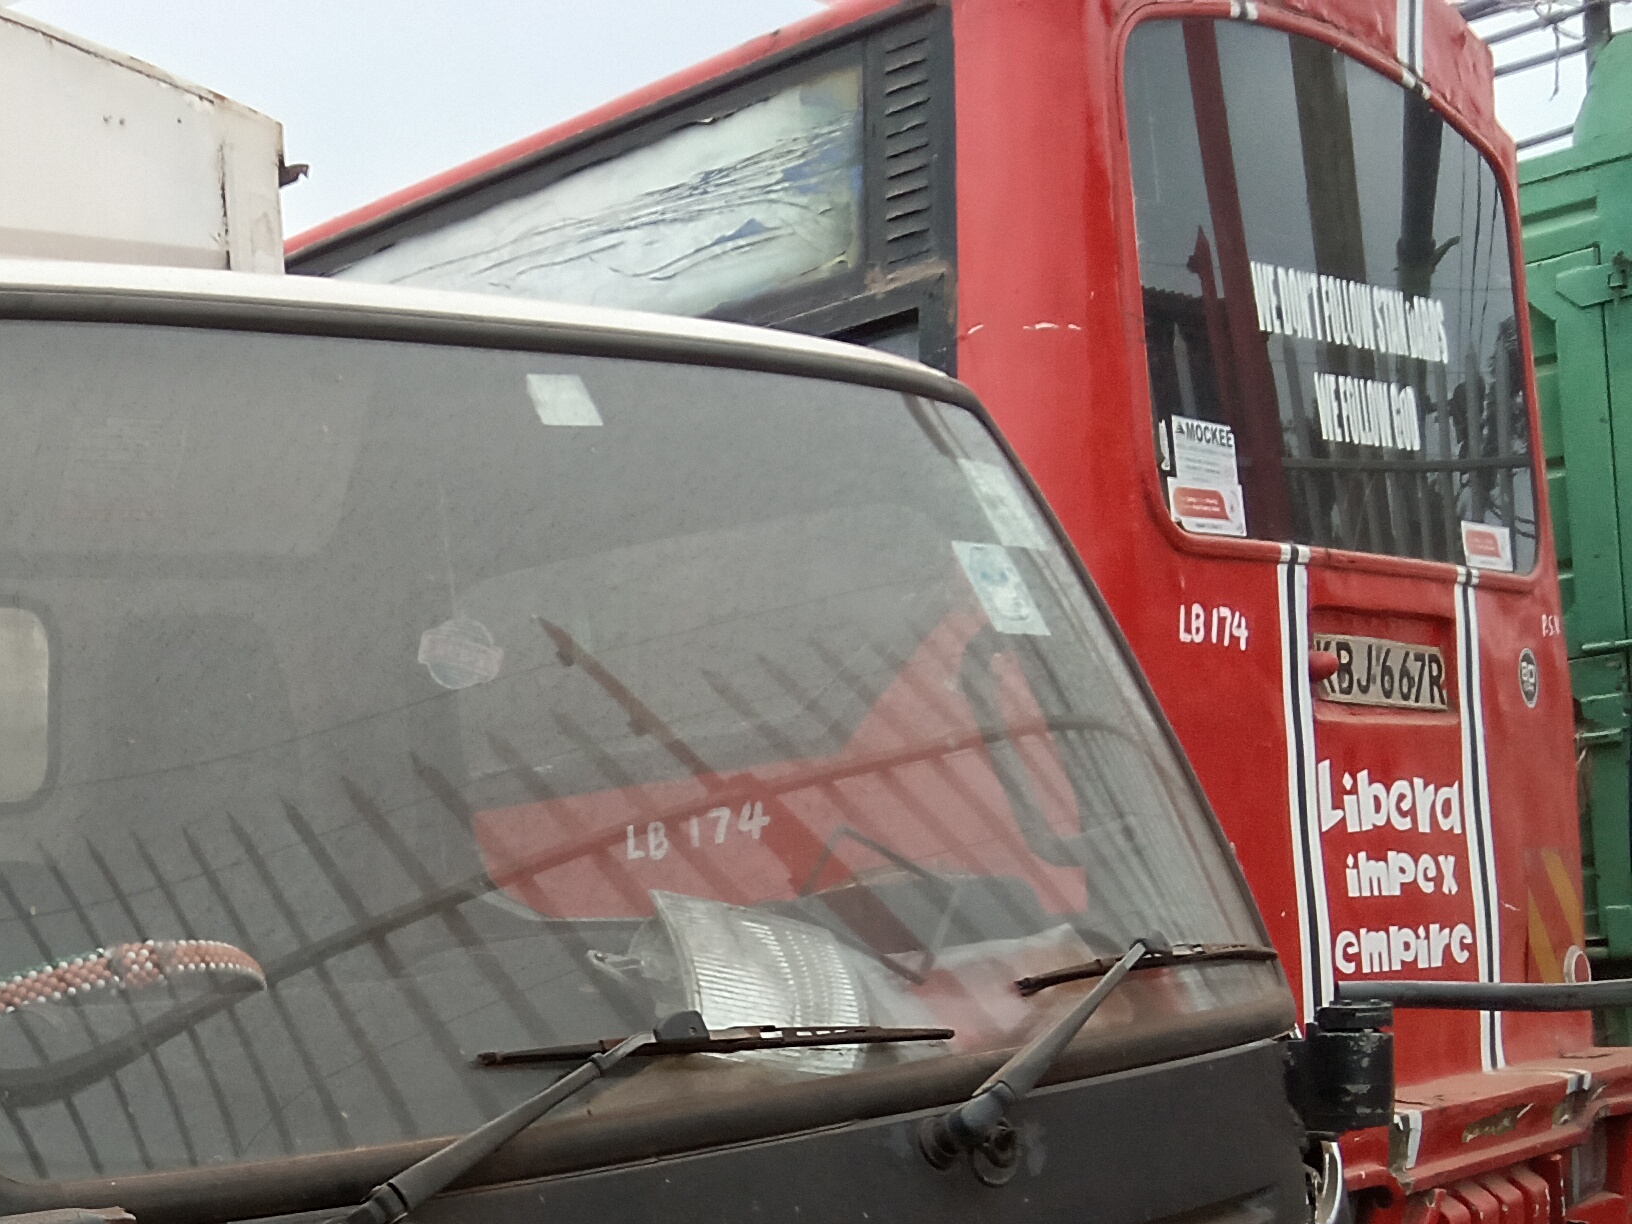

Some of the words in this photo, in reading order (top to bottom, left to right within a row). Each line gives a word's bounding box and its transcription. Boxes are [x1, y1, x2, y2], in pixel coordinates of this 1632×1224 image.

[1250, 260, 1282, 334] WE
[1320, 274, 1376, 351] FOLLOW
[1314, 371, 1343, 442] WE
[1338, 375, 1393, 448] FOLLOW
[1390, 381, 1421, 451] GOD
[1179, 602, 1205, 643] LB
[1211, 605, 1249, 651] 174
[1380, 647, 1447, 706] 667R
[1317, 758, 1463, 834] Libera
[626, 820, 668, 861] LB
[689, 800, 772, 848] 174
[1345, 850, 1459, 897] impex
[1334, 922, 1474, 975] empire
